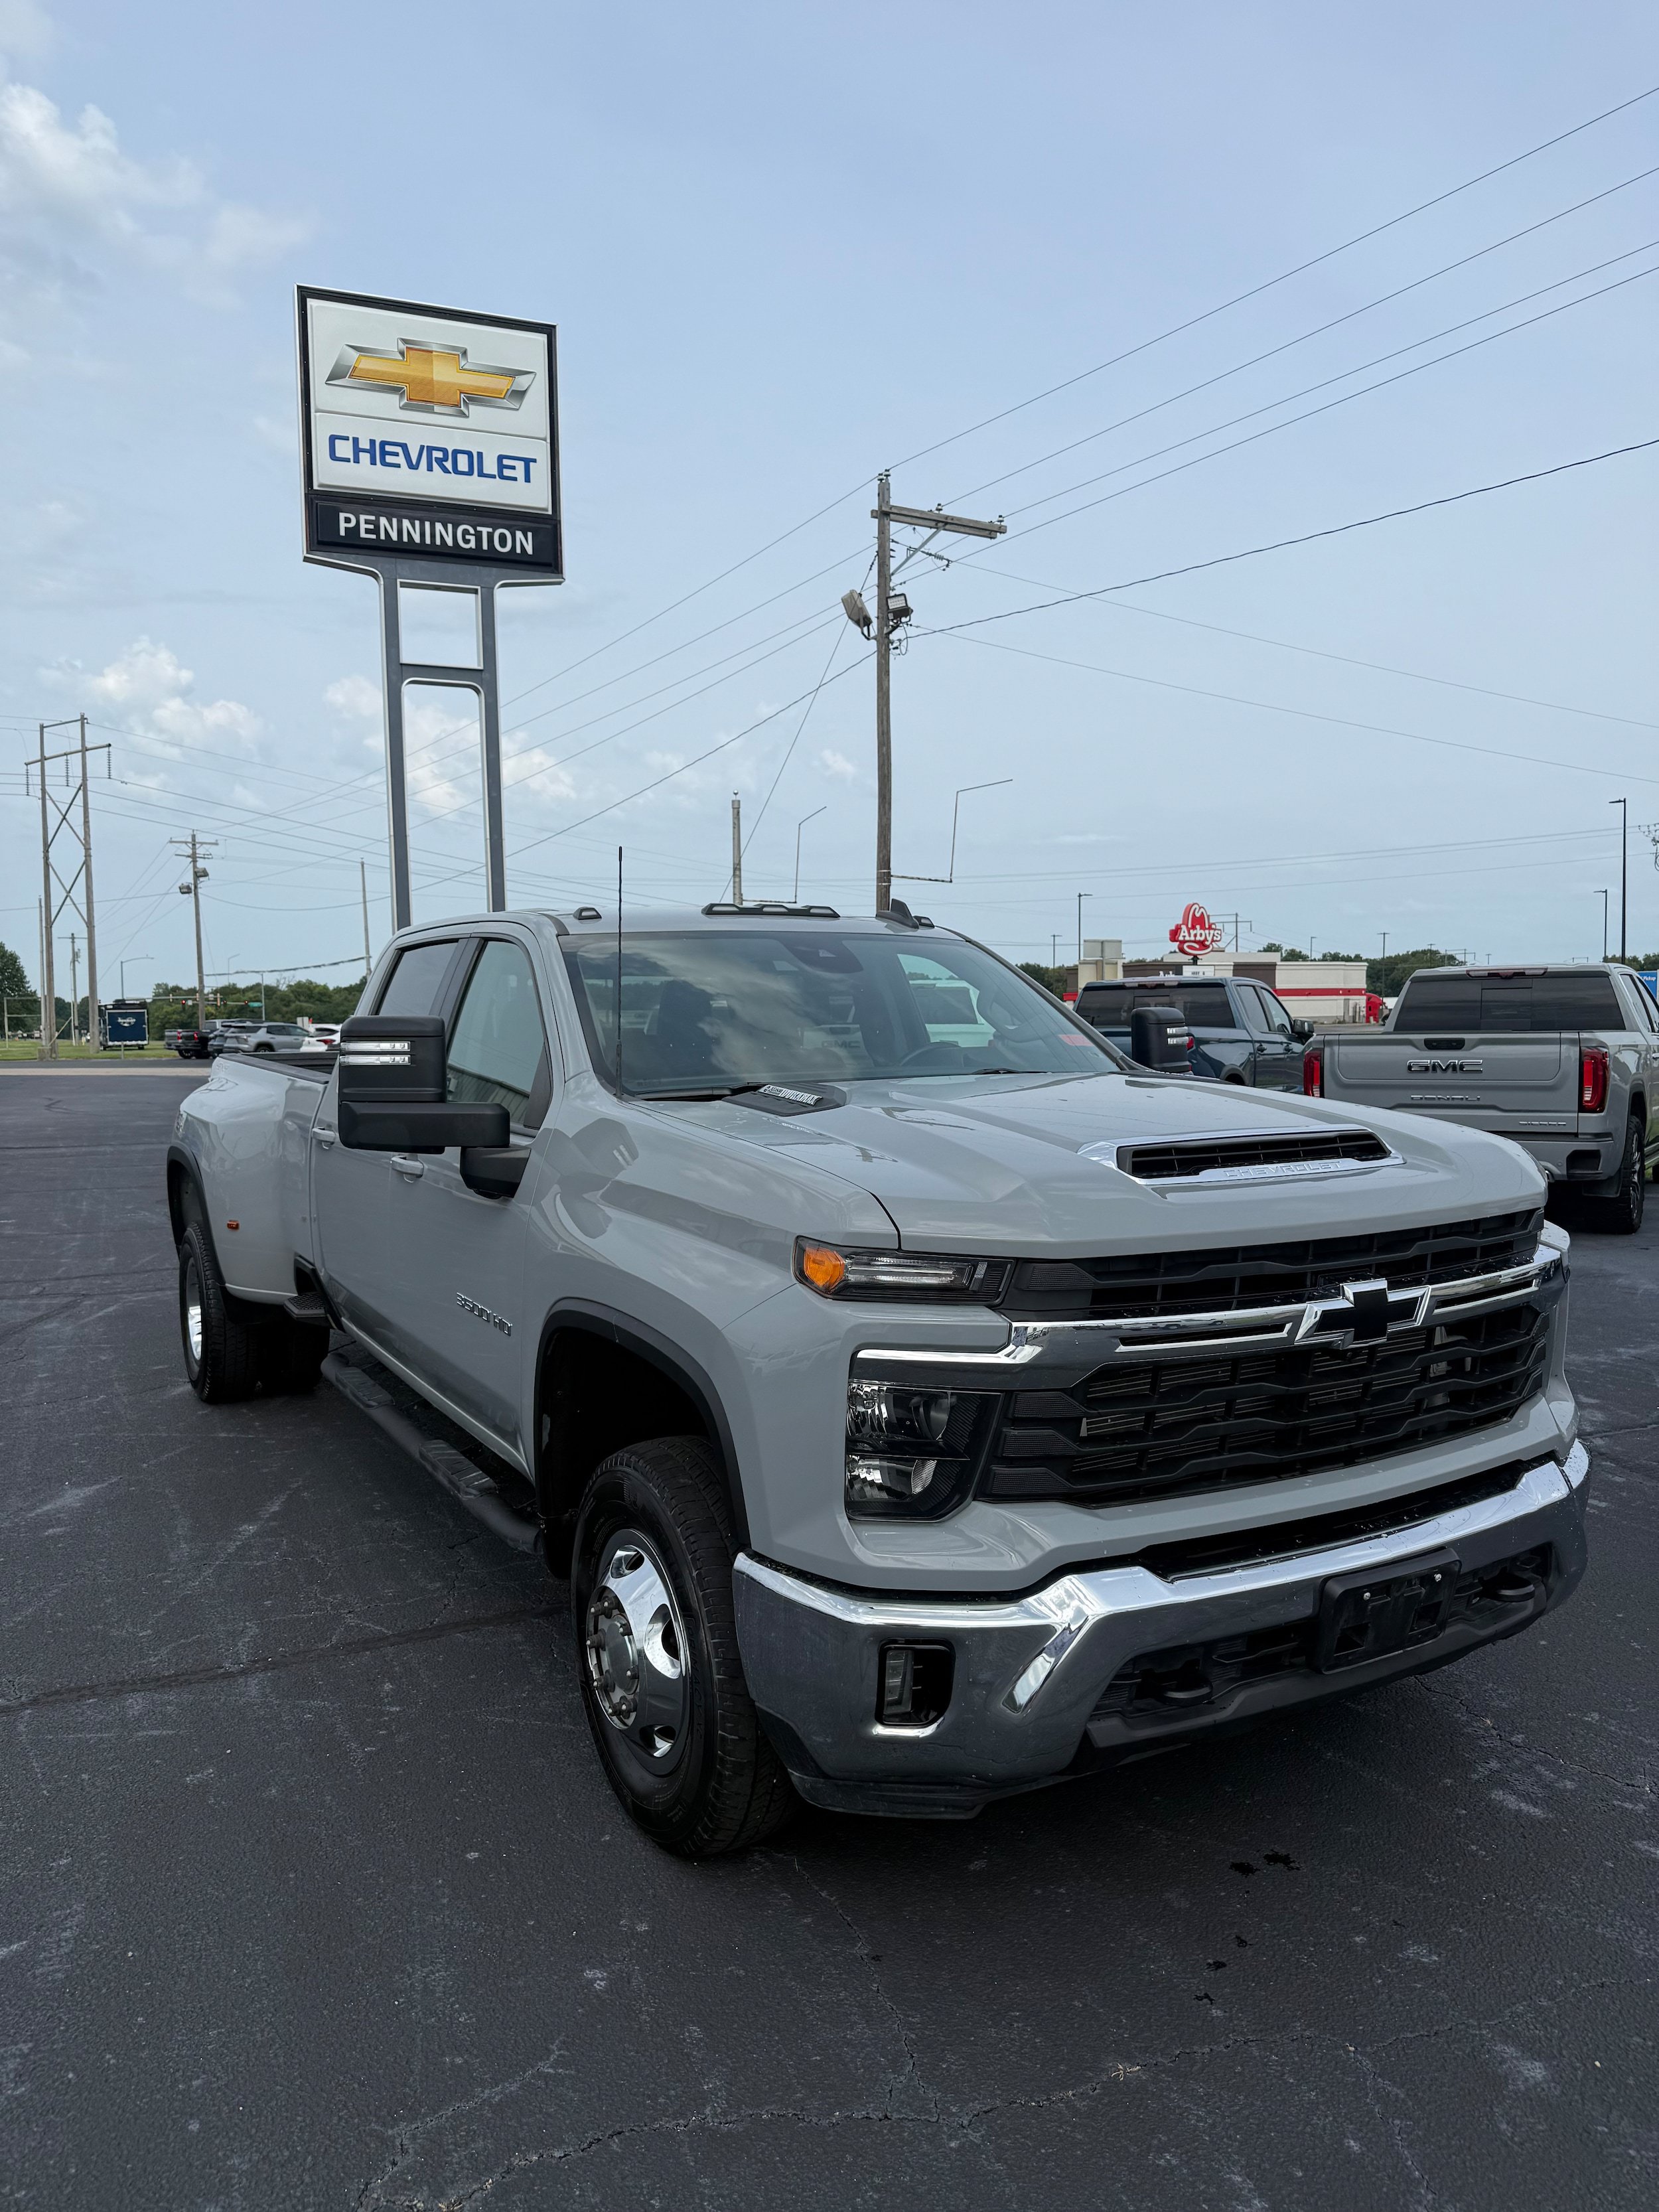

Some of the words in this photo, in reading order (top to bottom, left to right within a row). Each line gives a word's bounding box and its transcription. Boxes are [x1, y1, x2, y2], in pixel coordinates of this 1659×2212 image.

[328, 433, 538, 484] CHEVROLET
[338, 511, 534, 555] PENNINGTON
[1178, 924, 1222, 946] Arby's
[1407, 1059, 1483, 1074] GMC
[1224, 1161, 1341, 1178] CHEVROLET
[456, 1291, 492, 1323] 3500
[493, 1313, 513, 1337] HD
